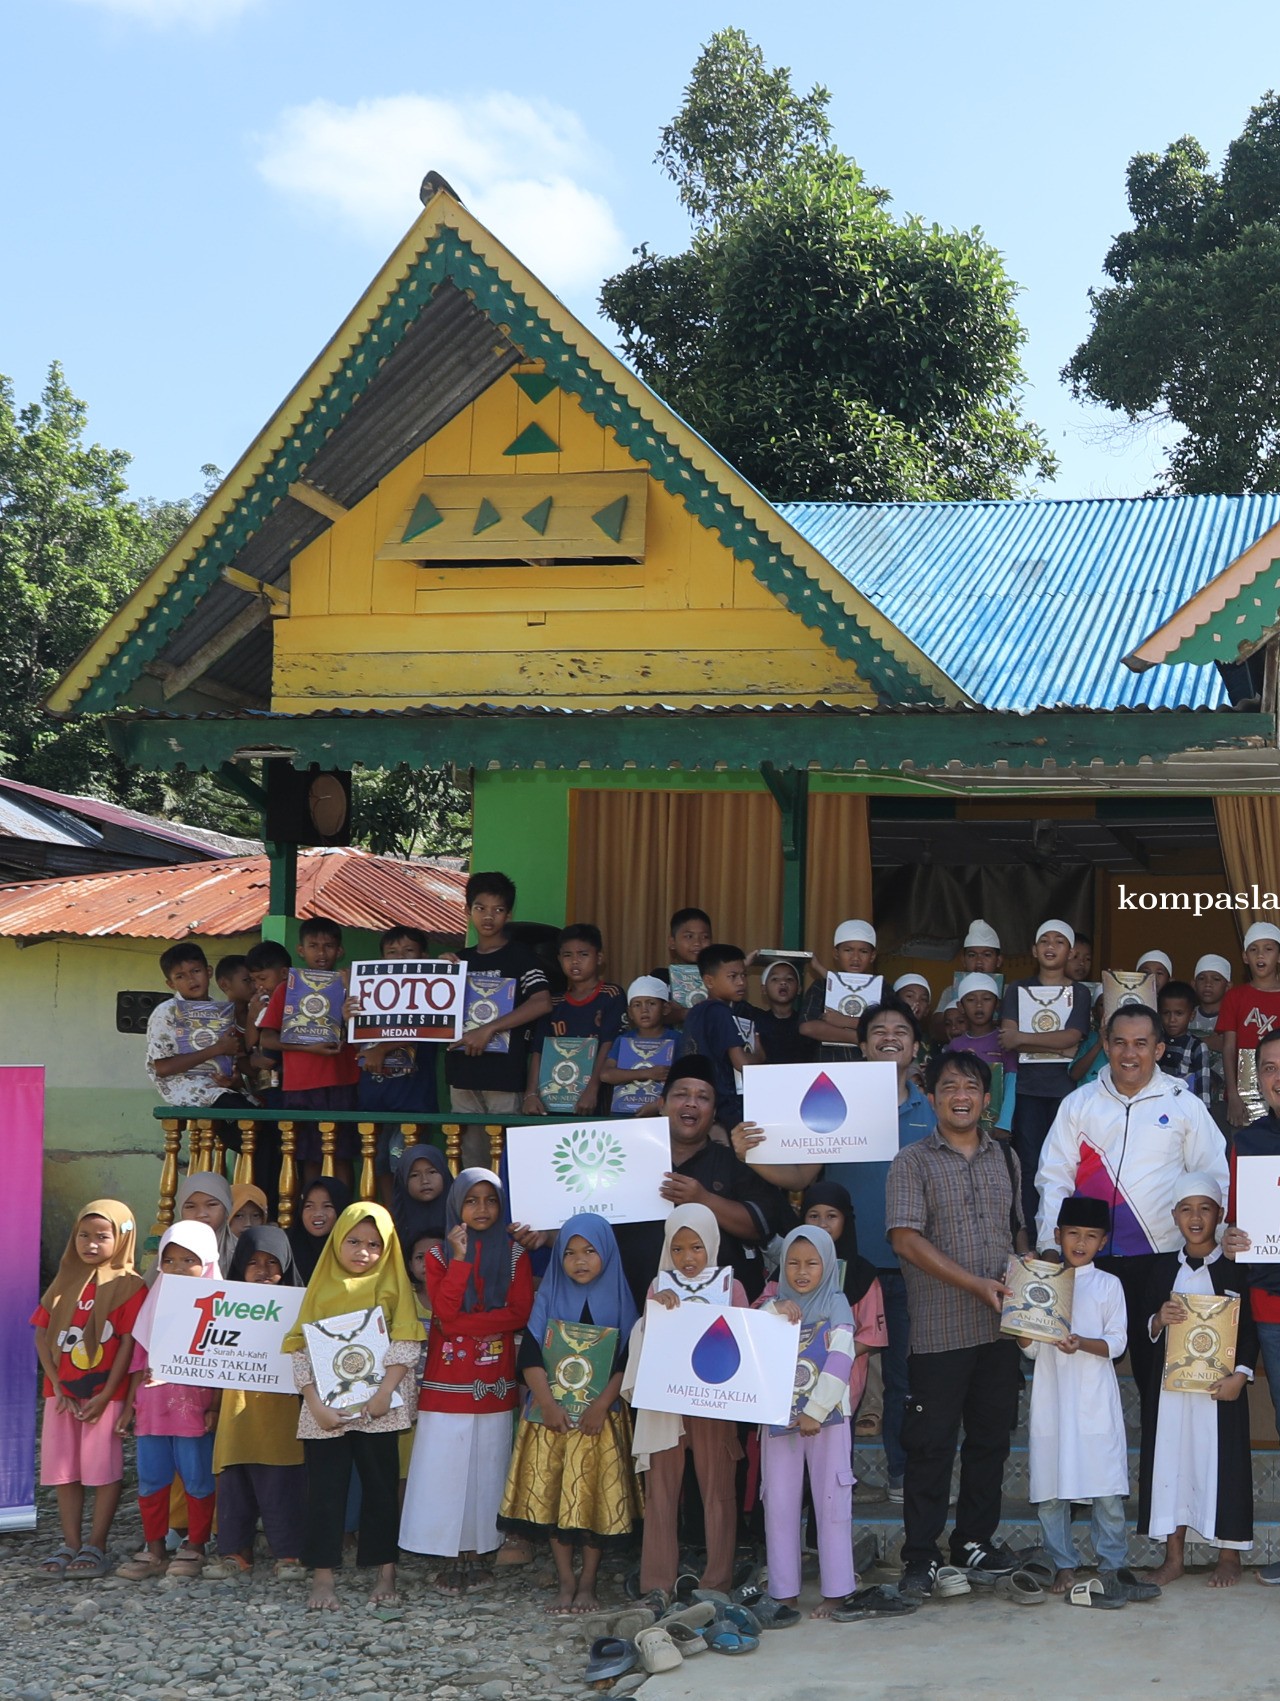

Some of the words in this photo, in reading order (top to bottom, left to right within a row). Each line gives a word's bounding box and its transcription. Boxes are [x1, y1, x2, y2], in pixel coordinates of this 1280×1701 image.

[361, 963, 453, 975] PEWARTA
[358, 977, 456, 1011] FOTO
[358, 1014, 449, 1026] INDONESIA
[293, 1026, 330, 1037] AN-NUR
[381, 1028, 417, 1037] MEDAN
[551, 1021, 568, 1036] 10
[780, 1138, 824, 1148] MAJELIS
[828, 1136, 868, 1147] TAKLIM
[806, 1147, 842, 1155] XLSMART
[572, 1203, 614, 1217] JAMPI
[214, 1299, 283, 1322] week
[1017, 1312, 1057, 1328] AN-NUR
[198, 1322, 241, 1349] juz
[213, 1347, 236, 1357] Surah
[237, 1350, 268, 1360] Al-Kahfi
[172, 1354, 218, 1368] MAJELIS
[221, 1359, 267, 1373] TAKLIM
[160, 1364, 215, 1379] TADARUS
[217, 1370, 236, 1381] AL
[238, 1373, 280, 1385] KAHFI
[1180, 1370, 1220, 1381] AN-NUR
[666, 1384, 710, 1398] MAJELIS
[713, 1389, 758, 1404] TAKLIM
[690, 1398, 728, 1410] XLSMART
